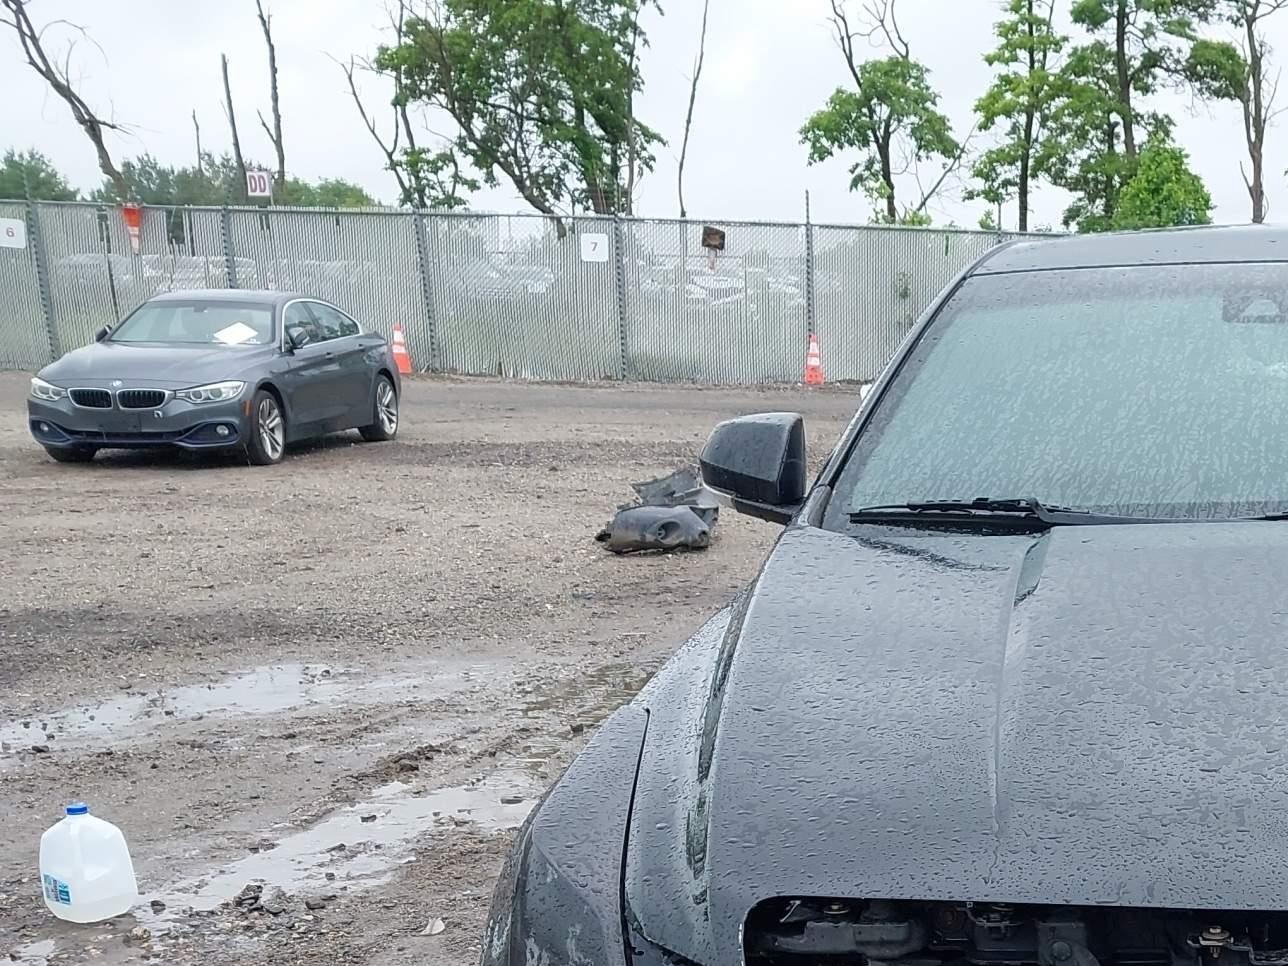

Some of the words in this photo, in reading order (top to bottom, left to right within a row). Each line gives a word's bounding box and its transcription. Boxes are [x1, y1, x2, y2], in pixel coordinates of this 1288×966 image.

[249, 174, 267, 193] DD
[6, 227, 15, 237] 6
[591, 242, 598, 251] 7
